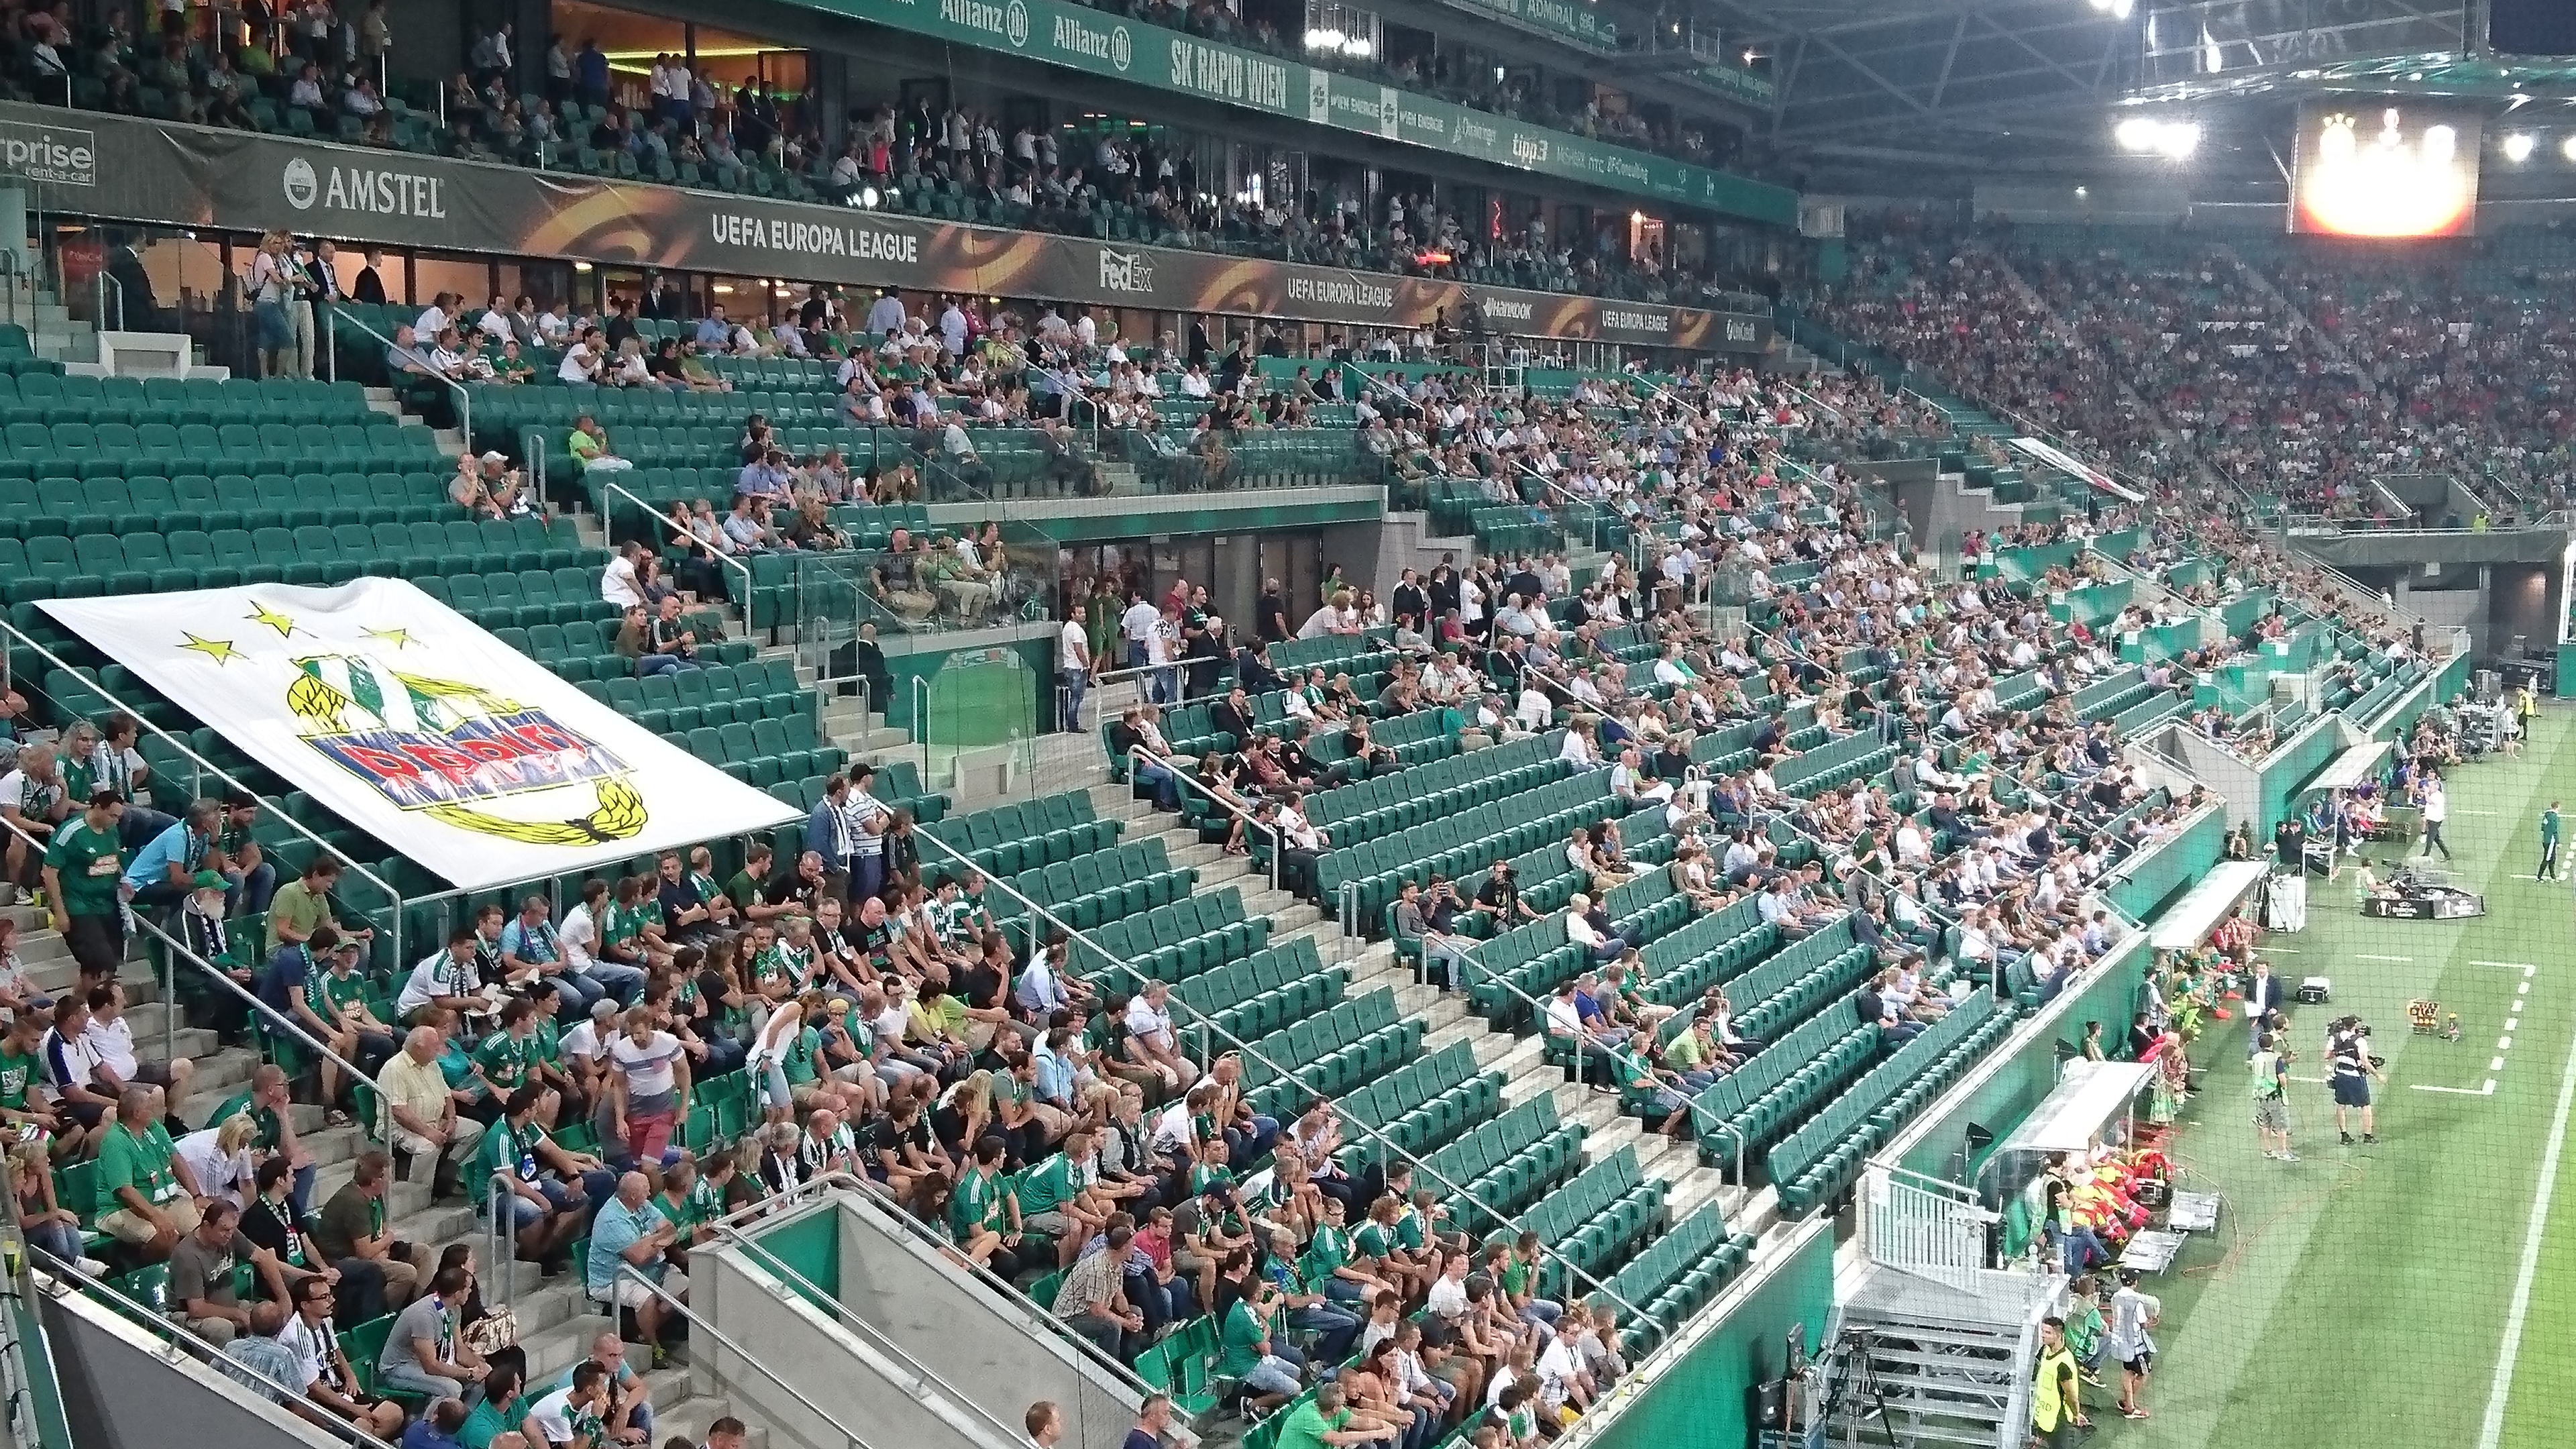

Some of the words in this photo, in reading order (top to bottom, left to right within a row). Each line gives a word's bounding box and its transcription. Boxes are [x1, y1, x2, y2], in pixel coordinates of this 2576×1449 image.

[1053, 15, 1109, 59] Allianz
[1171, 39, 1193, 88] SK
[1197, 46, 1242, 99] RAPID
[1248, 58, 1286, 109] WIEN
[325, 166, 445, 218] AMSTEL
[712, 214, 767, 248] UEFA
[771, 220, 845, 256] EUROPA
[849, 229, 918, 262] LEAGUE
[1100, 250, 1152, 292] FedEx
[1288, 278, 1315, 301] UEFA
[1317, 280, 1354, 305] EUROPA
[1357, 284, 1393, 307] LEAGUE
[1603, 310, 1619, 328] UEFA
